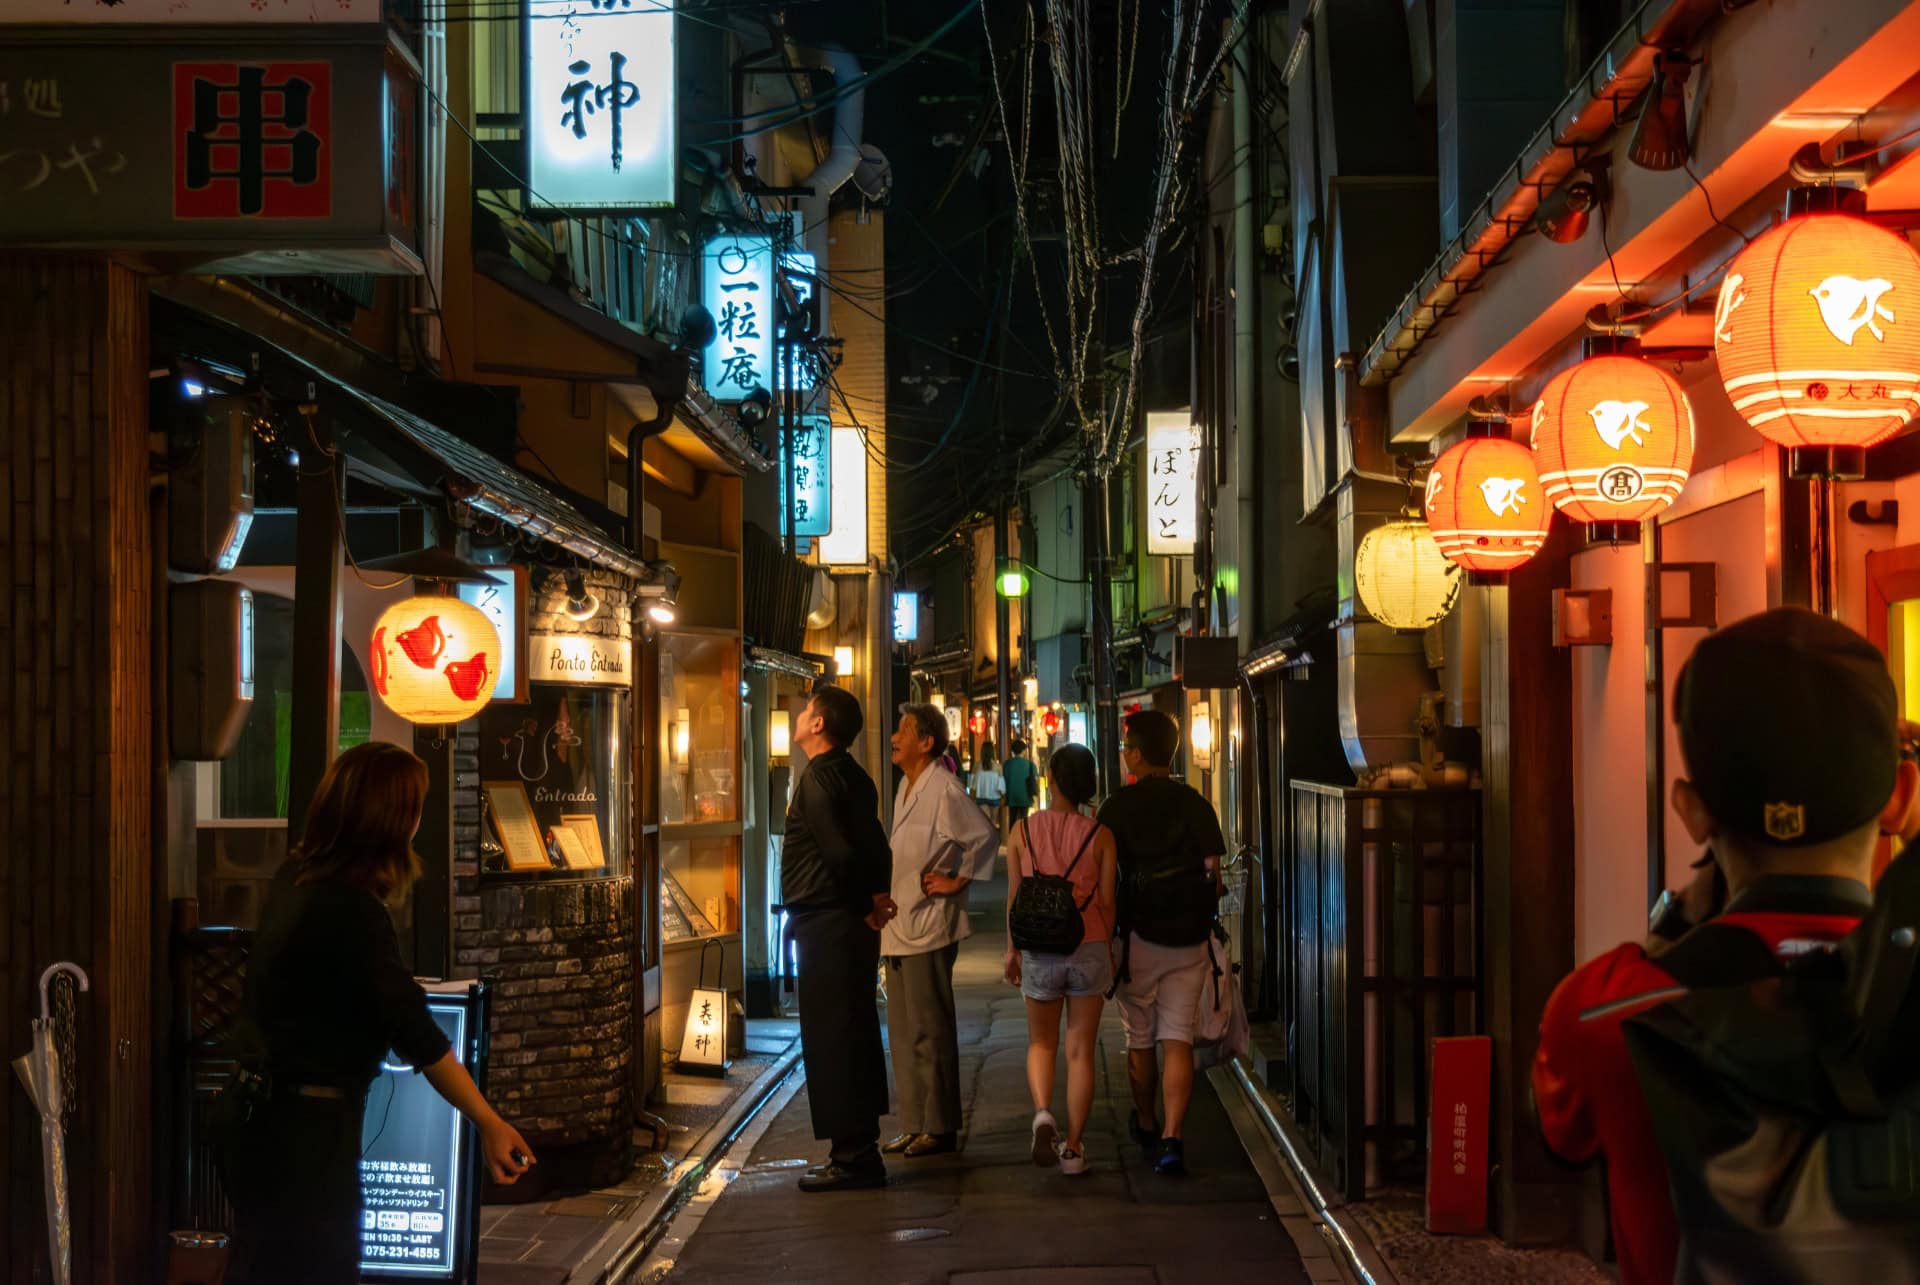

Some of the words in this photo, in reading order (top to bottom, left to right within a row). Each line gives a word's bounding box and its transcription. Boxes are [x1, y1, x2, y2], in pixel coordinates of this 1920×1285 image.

[560, 0, 641, 175] 神
[186, 66, 321, 216] 串
[716, 281, 762, 392] 一粒庵
[1152, 447, 1182, 539] ぽんと
[550, 647, 586, 671] Ponto
[590, 649, 623, 673] Entrada
[535, 785, 597, 802] Entrada
[365, 1245, 441, 1259] 075-231-4555
[410, 1234, 433, 1244] LAST
